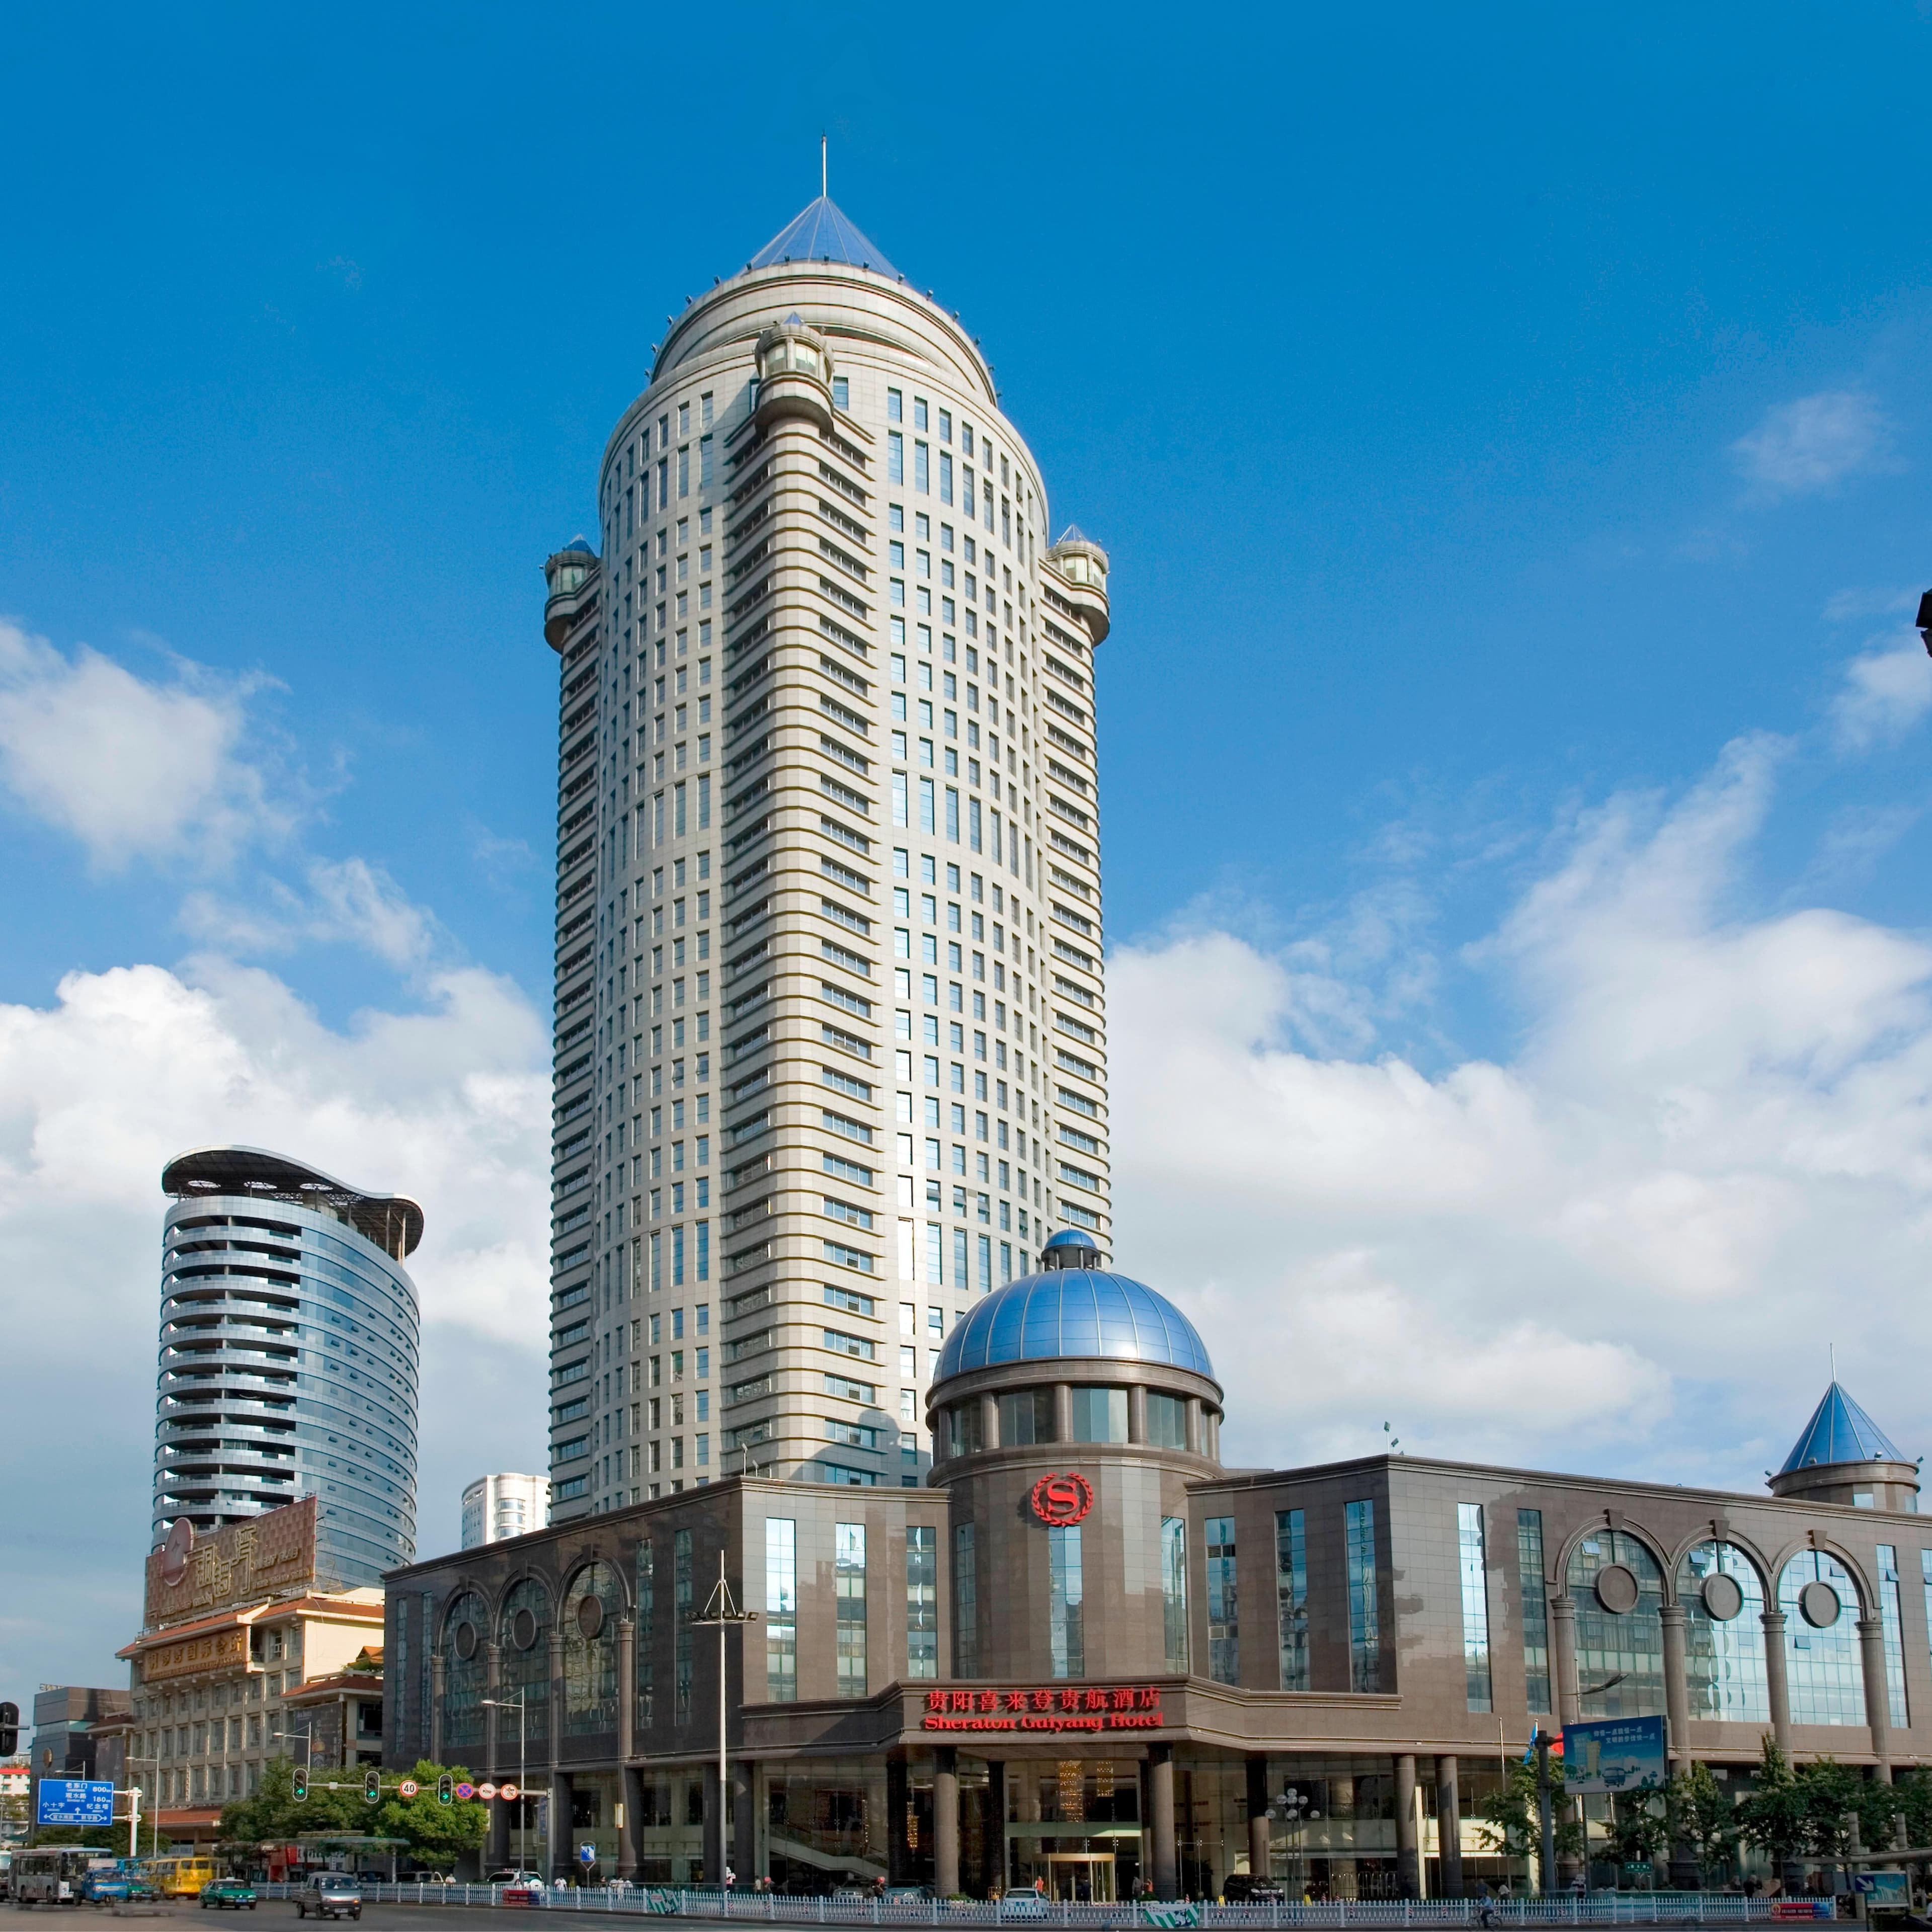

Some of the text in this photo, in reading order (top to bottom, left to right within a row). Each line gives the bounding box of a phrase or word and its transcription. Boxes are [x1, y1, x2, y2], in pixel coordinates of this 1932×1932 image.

[1048, 1482, 1078, 1513] S
[929, 1687, 1159, 1710] 贵阳喜来登贵航酒店
[925, 1712, 1163, 1731] Sheraton Guiyang Hotel
[404, 1784, 415, 1792] 40
